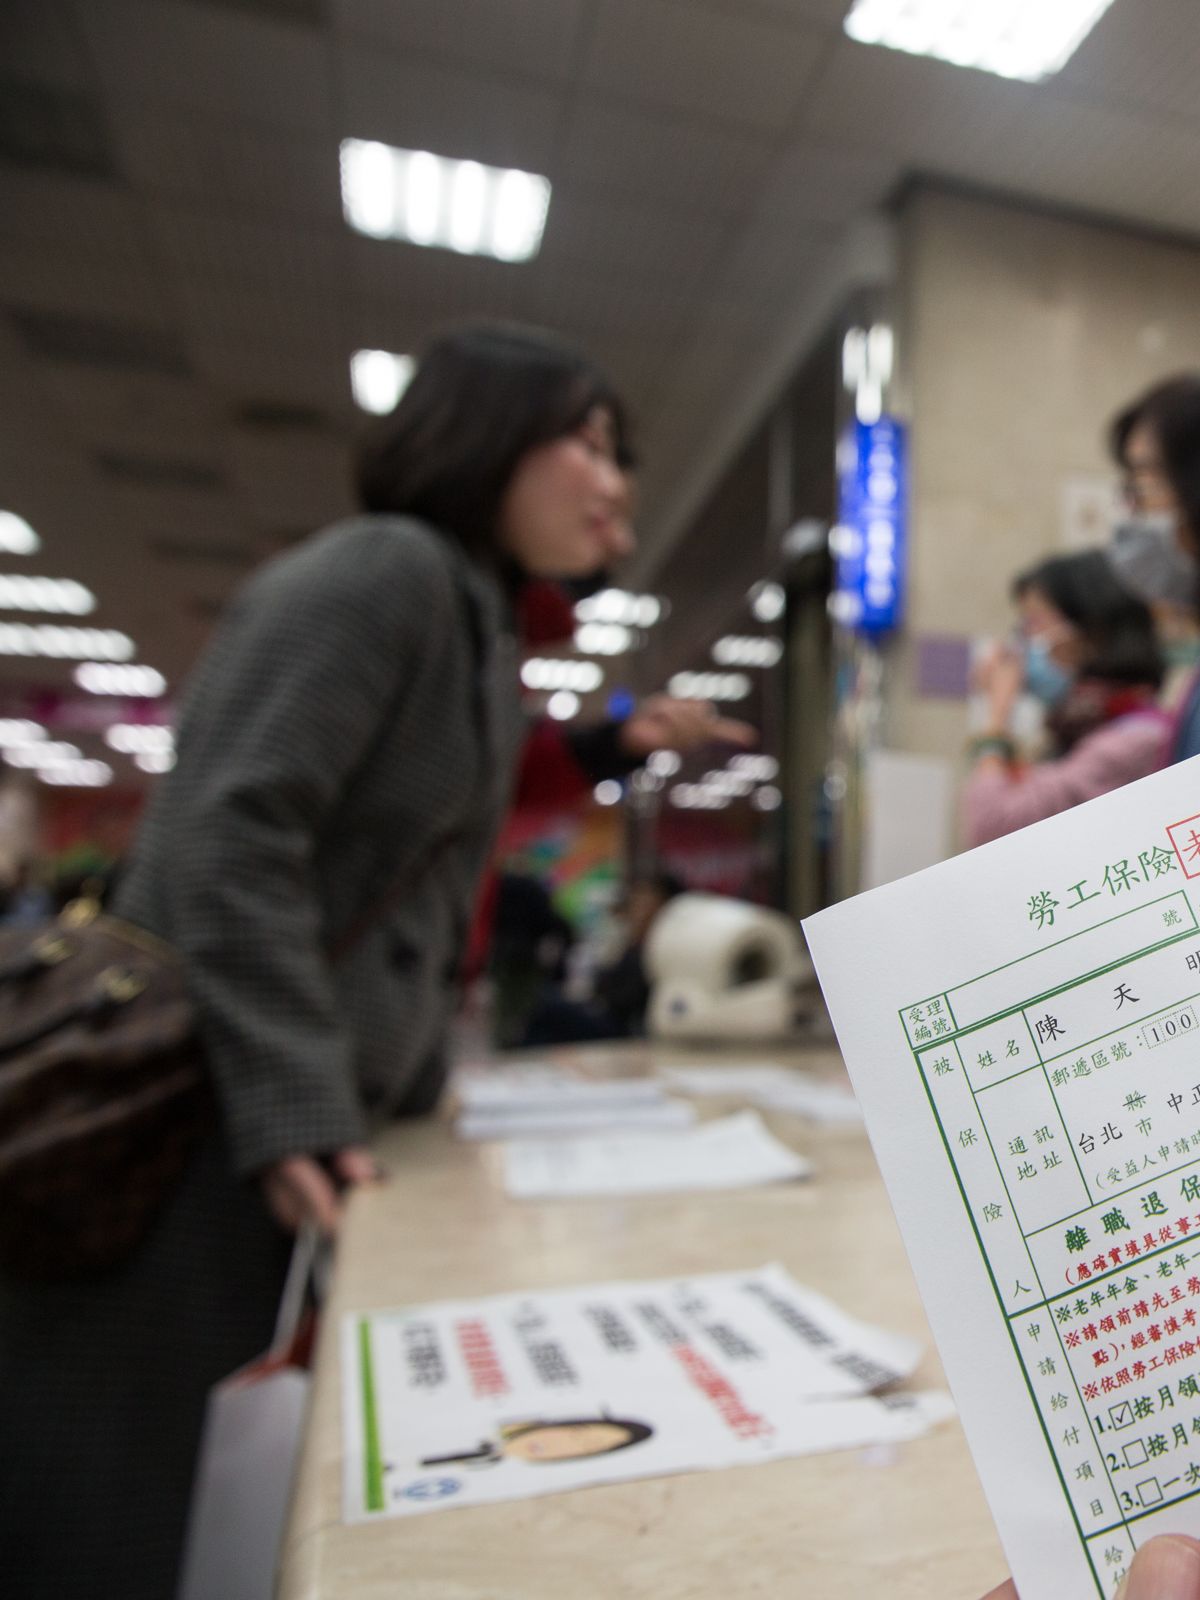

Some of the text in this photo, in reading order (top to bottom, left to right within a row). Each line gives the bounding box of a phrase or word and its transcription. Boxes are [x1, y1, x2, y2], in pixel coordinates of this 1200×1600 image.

[1026, 846, 1178, 930] 勞工保險
[1162, 909, 1182, 927] 號
[1079, 1122, 1123, 1155] 台北
